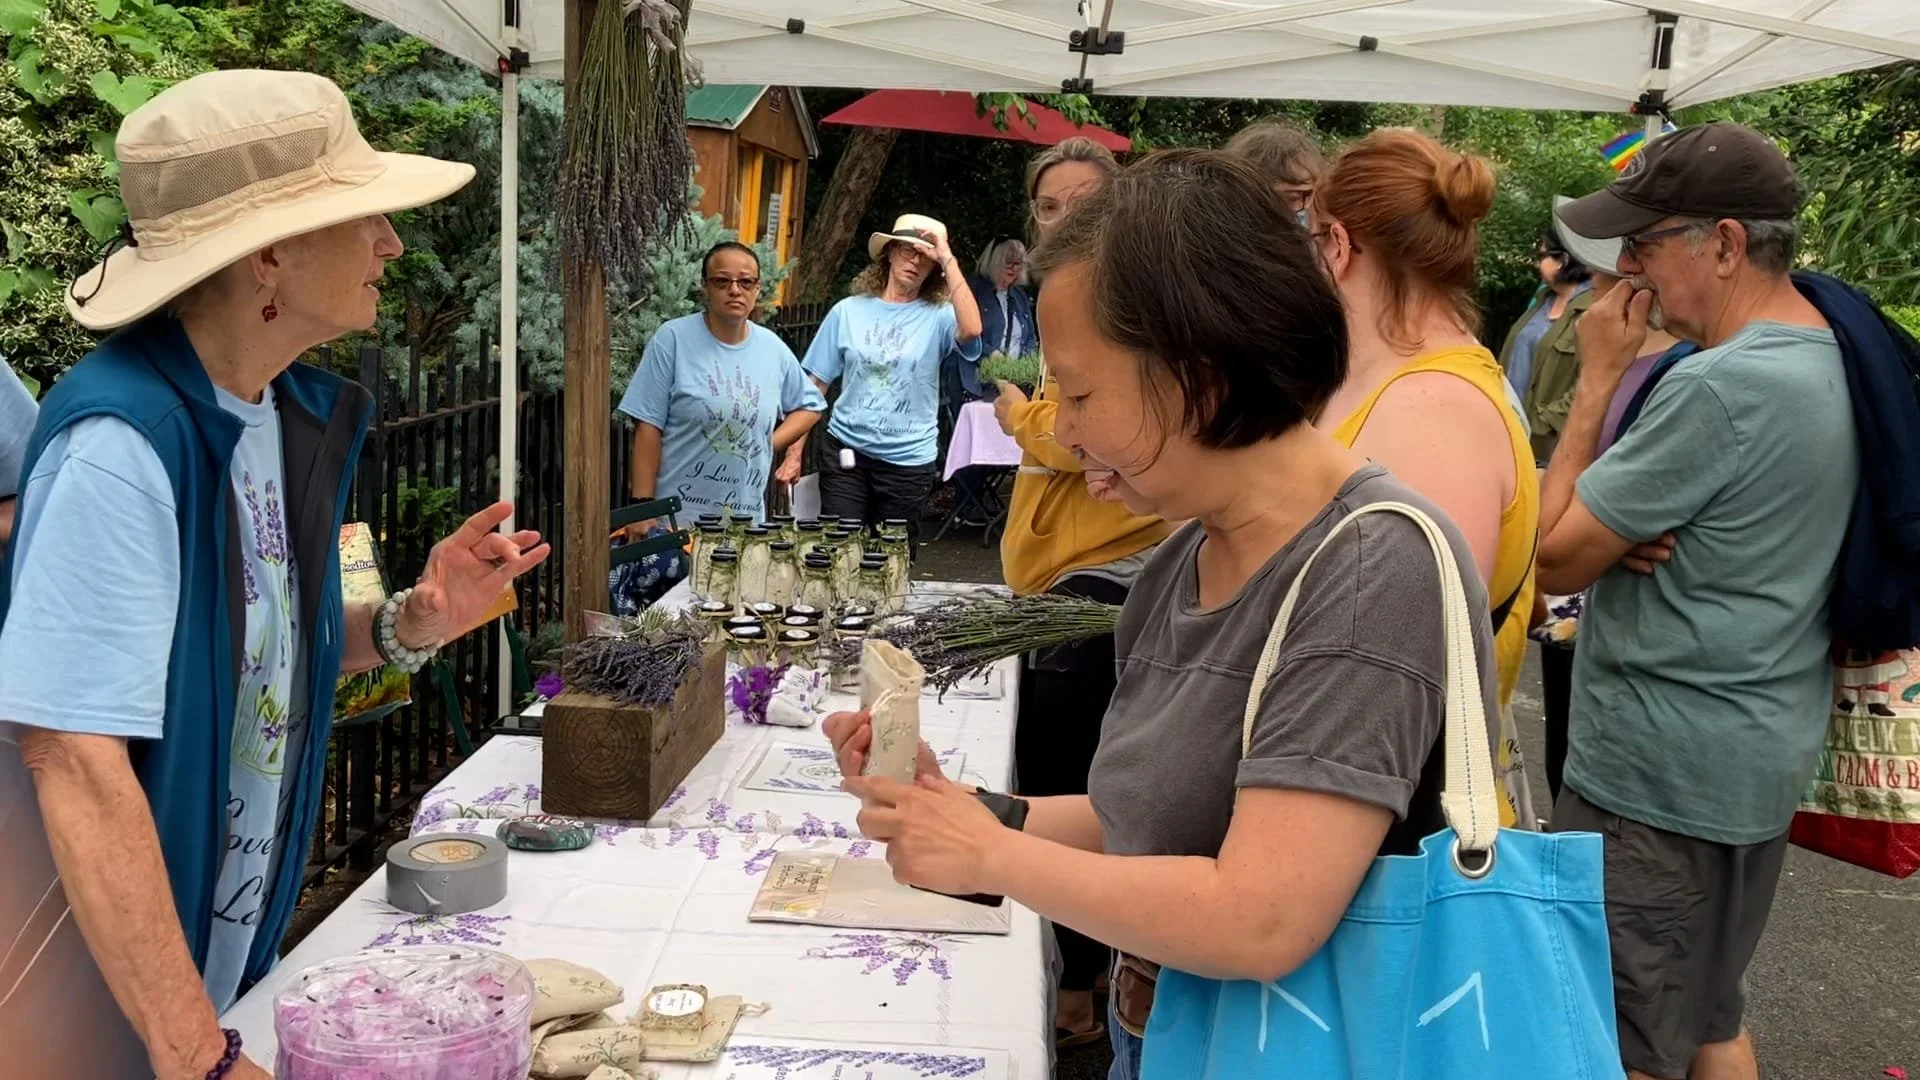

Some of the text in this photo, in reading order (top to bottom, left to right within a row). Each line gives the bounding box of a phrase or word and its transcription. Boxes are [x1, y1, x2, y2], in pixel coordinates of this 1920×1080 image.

[685, 461, 763, 489] I Love M
[677, 483, 711, 506] Some
[1836, 754, 1882, 789] CALM
[1886, 758, 1901, 789] &
